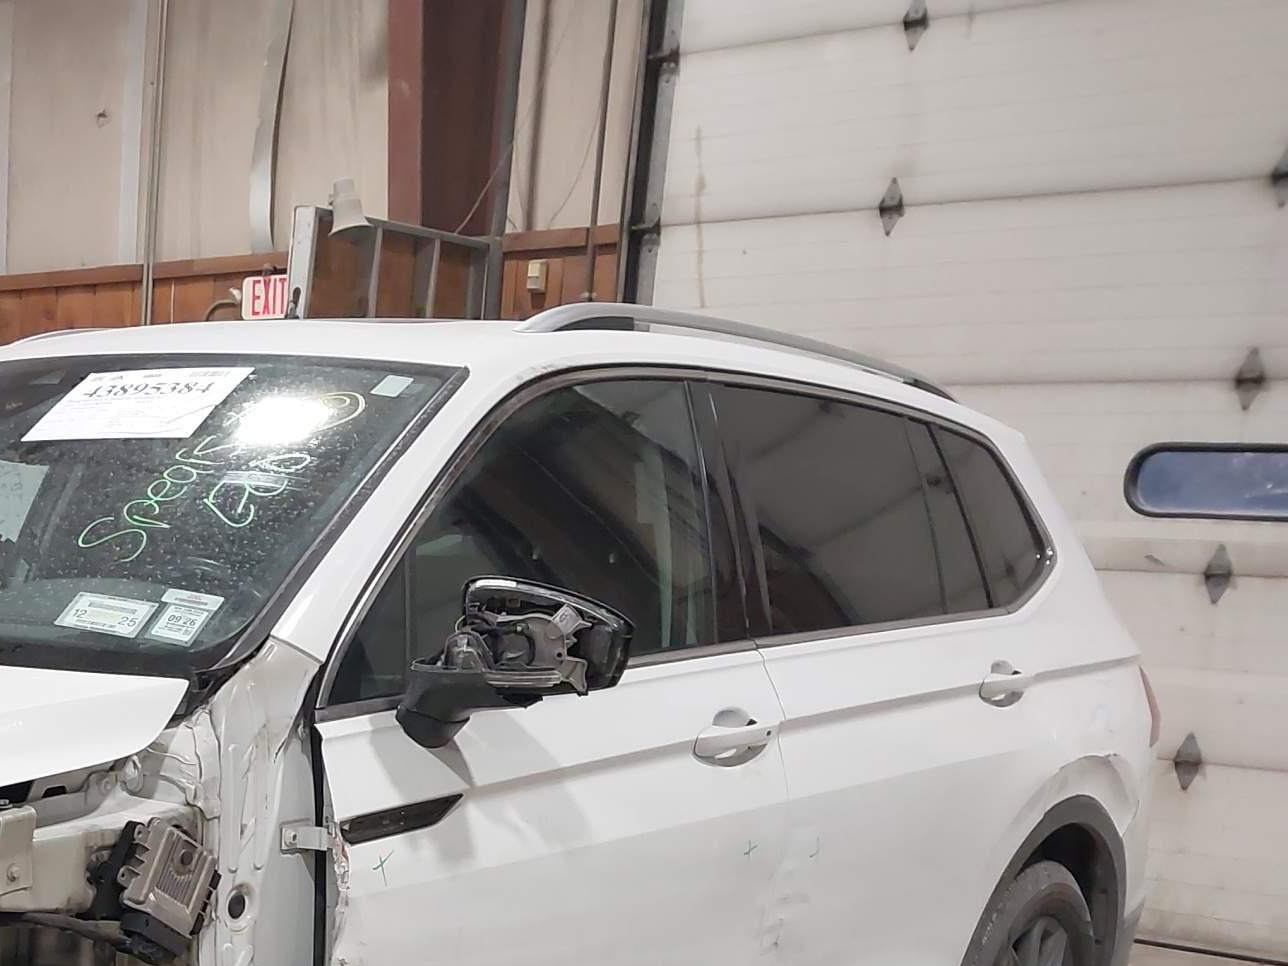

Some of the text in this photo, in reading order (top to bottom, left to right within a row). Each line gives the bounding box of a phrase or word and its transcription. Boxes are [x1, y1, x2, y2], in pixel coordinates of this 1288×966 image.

[251, 278, 287, 316] EXIT
[83, 381, 215, 398] 43895384
[73, 608, 89, 619] 12
[117, 616, 139, 628] 25
[167, 614, 198, 627] 09 26
